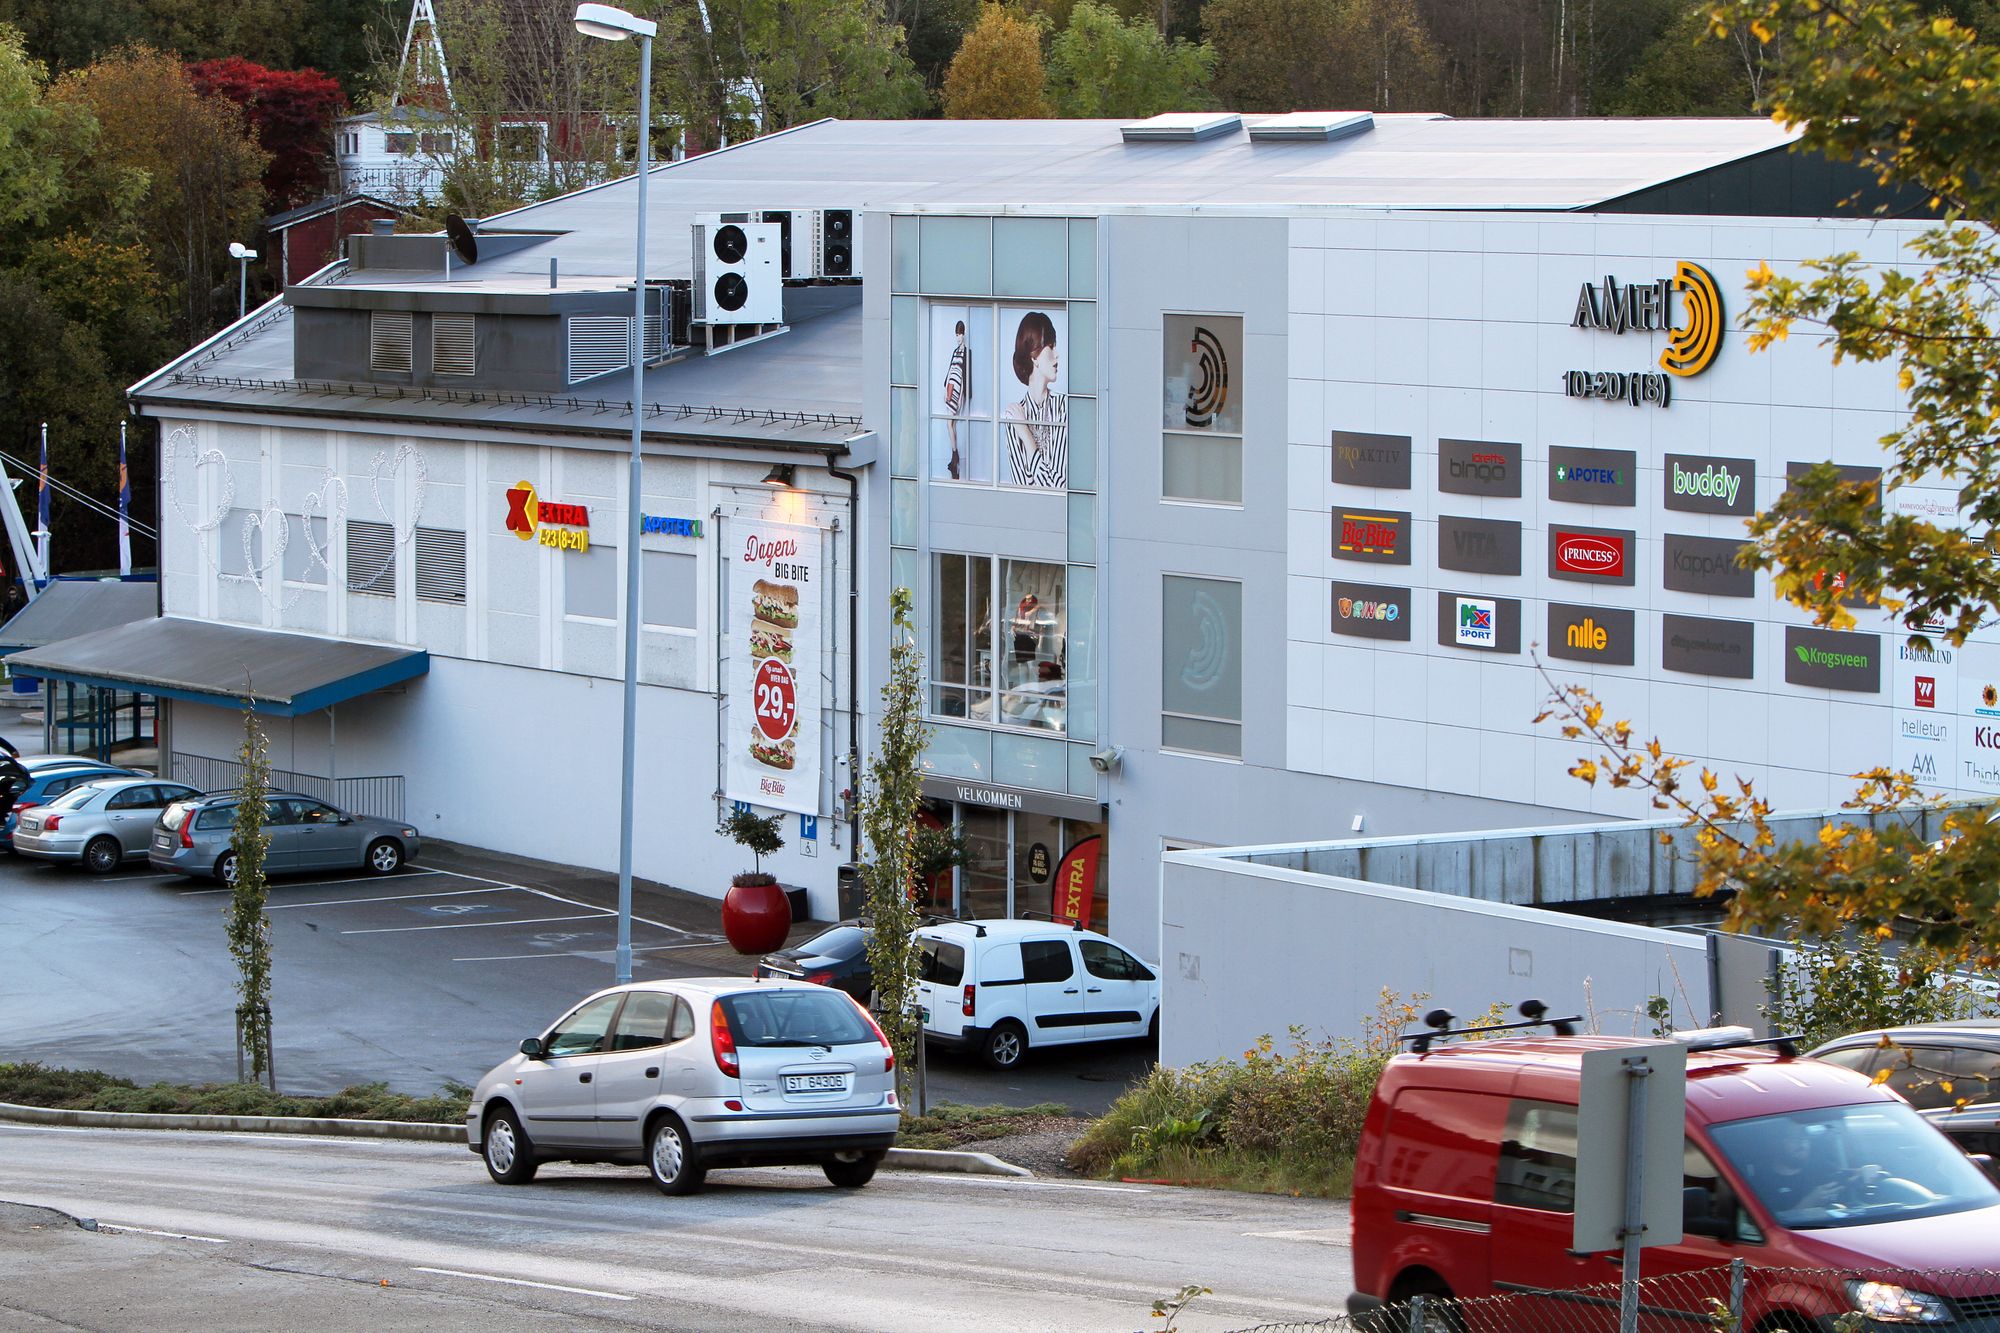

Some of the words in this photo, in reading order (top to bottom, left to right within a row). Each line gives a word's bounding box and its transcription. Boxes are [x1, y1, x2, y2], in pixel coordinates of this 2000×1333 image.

[1570, 275, 1672, 335] AMFI
[1562, 371, 1622, 399] 10-20
[1626, 372, 1669, 408] (18)
[1338, 446, 1401, 469] PROAKTIV
[1450, 457, 1506, 484] bingo
[1567, 466, 1616, 485] APOTEK
[1617, 468, 1625, 485] 1
[1673, 462, 1740, 507] buddy
[538, 502, 589, 528] EXTRA
[644, 515, 692, 537] APOTEK
[558, 528, 586, 554] (8-21)
[1341, 521, 1365, 553] Big
[1365, 524, 1397, 548] Bite
[743, 535, 798, 567] Dagens
[1568, 547, 1613, 563] PRINCESS
[775, 562, 789, 579] BIG
[791, 565, 809, 582] BITE
[1460, 629, 1491, 639] SPORT
[1567, 618, 1607, 650] nille
[1810, 647, 1867, 668] Krogsveen
[1902, 718, 1947, 738] helletun
[760, 778, 772, 796] Big
[772, 780, 785, 794] Bite
[957, 786, 1022, 809] VELKOMMEN
[1066, 858, 1085, 918] EXTRA
[788, 1077, 802, 1089] ST
